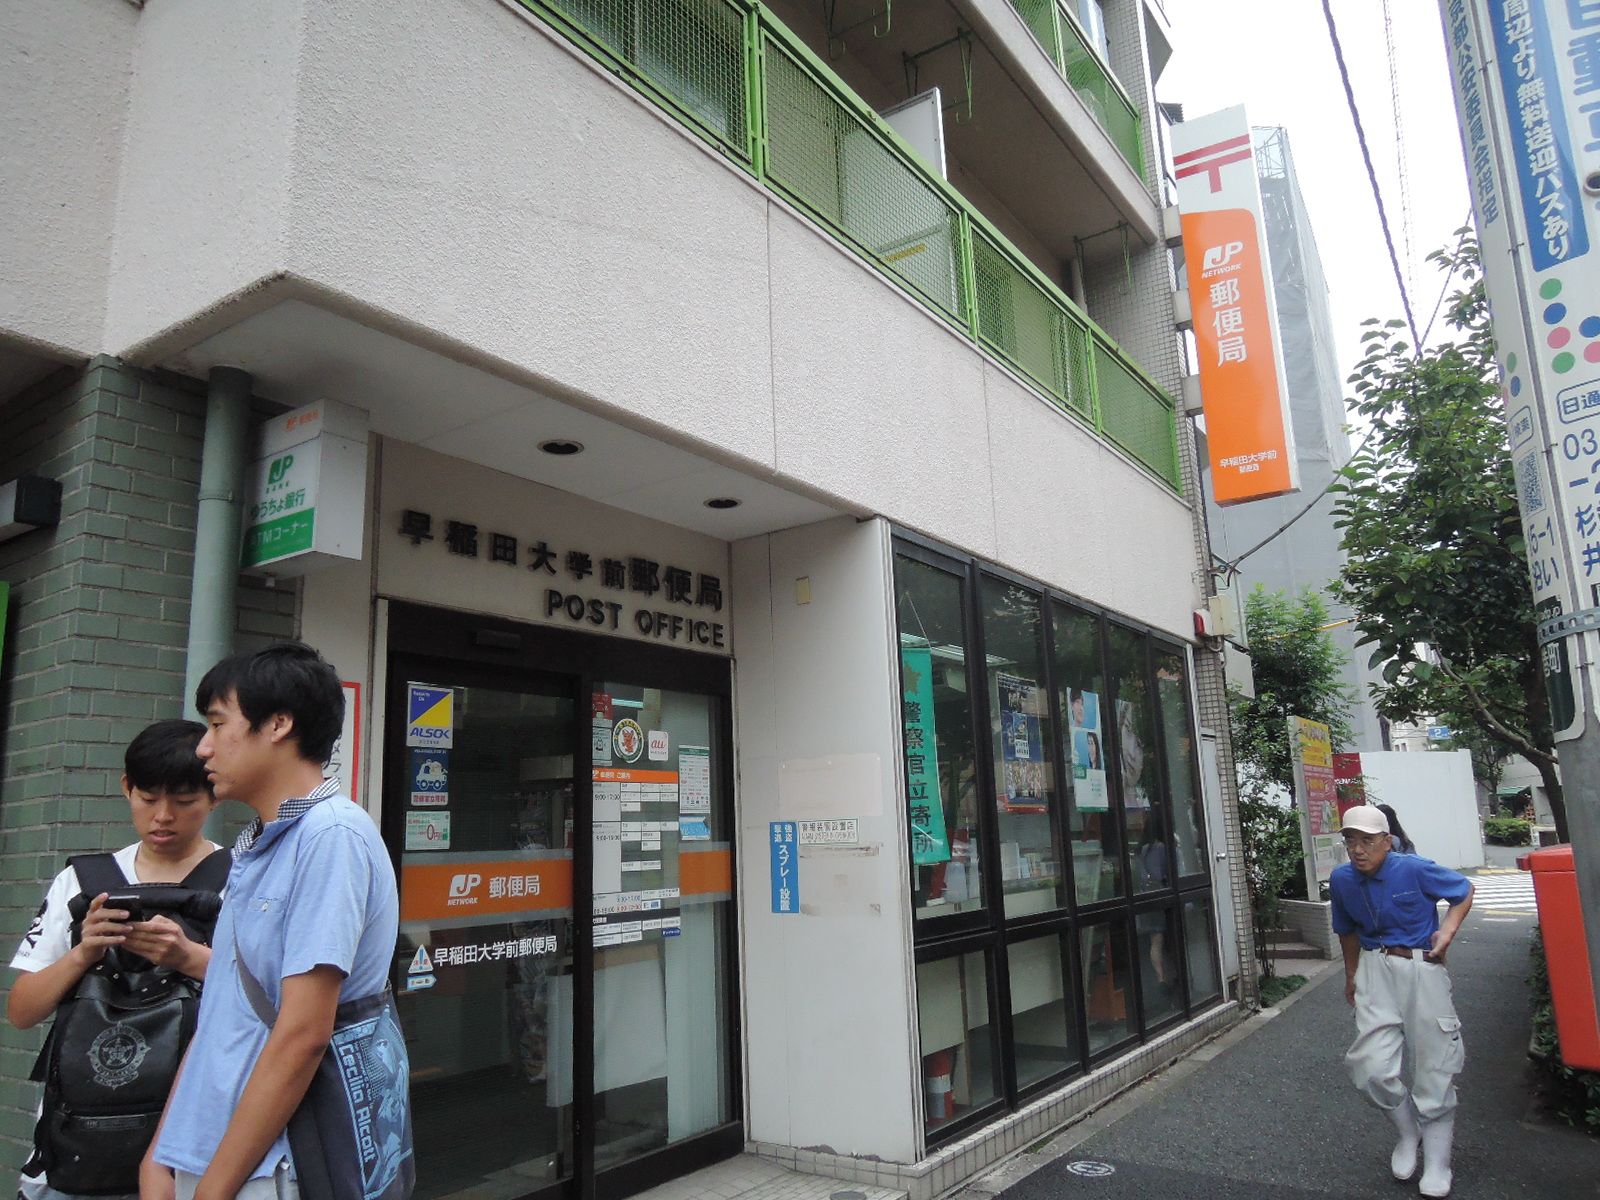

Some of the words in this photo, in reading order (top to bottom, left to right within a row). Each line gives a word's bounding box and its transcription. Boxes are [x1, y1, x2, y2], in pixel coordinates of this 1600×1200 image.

[1202, 263, 1242, 279] NETWORK
[1208, 277, 1248, 368] 郵便局
[1218, 449, 1278, 470] 早稲田大学前
[1562, 427, 1599, 461] 03
[398, 508, 724, 612] 早稲田大学前郵便局
[544, 589, 624, 630] POST
[635, 609, 725, 648] OFFICE
[410, 727, 450, 739] ALSOK
[650, 738, 667, 750] au
[904, 701, 934, 854] 警察官立寄所
[489, 874, 540, 898] 郵便局
[778, 844, 791, 911] スプレー設置
[447, 896, 479, 906] NETWORK
[433, 935, 558, 968] 早稲田大学前郵便局
[356, 1106, 376, 1162] Alcott
